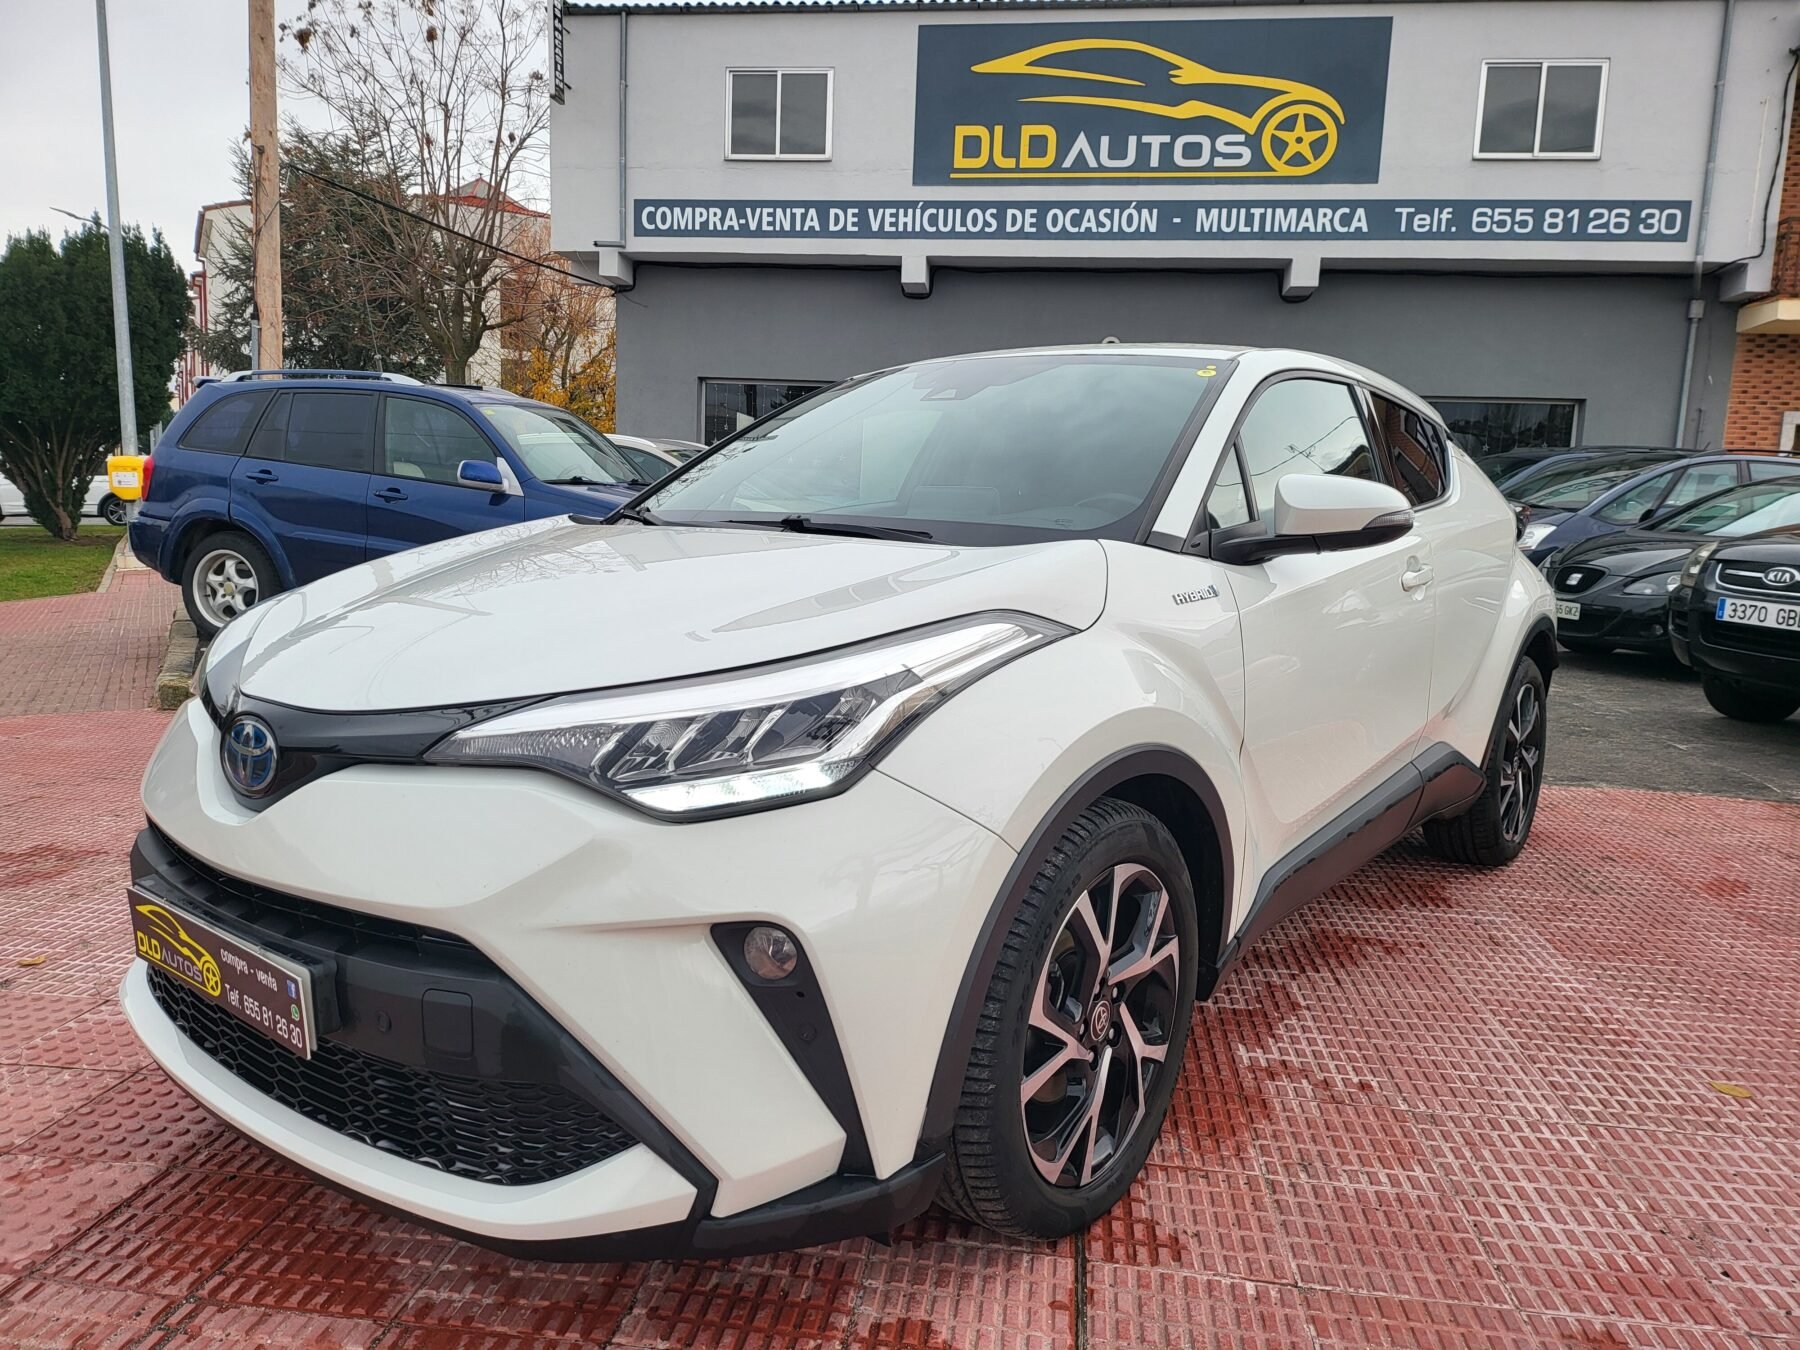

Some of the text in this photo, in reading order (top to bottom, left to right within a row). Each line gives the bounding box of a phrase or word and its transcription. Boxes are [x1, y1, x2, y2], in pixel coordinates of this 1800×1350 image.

[953, 124, 1252, 169] DLD AUTOS
[641, 206, 821, 232] COMPRA-VENTA
[828, 207, 859, 232] DE
[867, 202, 998, 233] VEHÍCULOS
[1005, 208, 1038, 233] DE
[1045, 202, 1158, 233] OCASIÓN
[1195, 207, 1369, 233] MULTIMARCA
[1394, 207, 1457, 233] Telf.
[1471, 207, 1534, 234] 655
[1638, 208, 1682, 235] 30
[1767, 571, 1792, 583] KIA
[1172, 587, 1215, 605] HYBRID
[1728, 602, 1768, 623] 3370
[136, 930, 203, 982] DLD AUTOS
[220, 948, 249, 975] compra
[255, 968, 278, 993] venta
[224, 983, 303, 1049] Telf. 655 81 26 30
